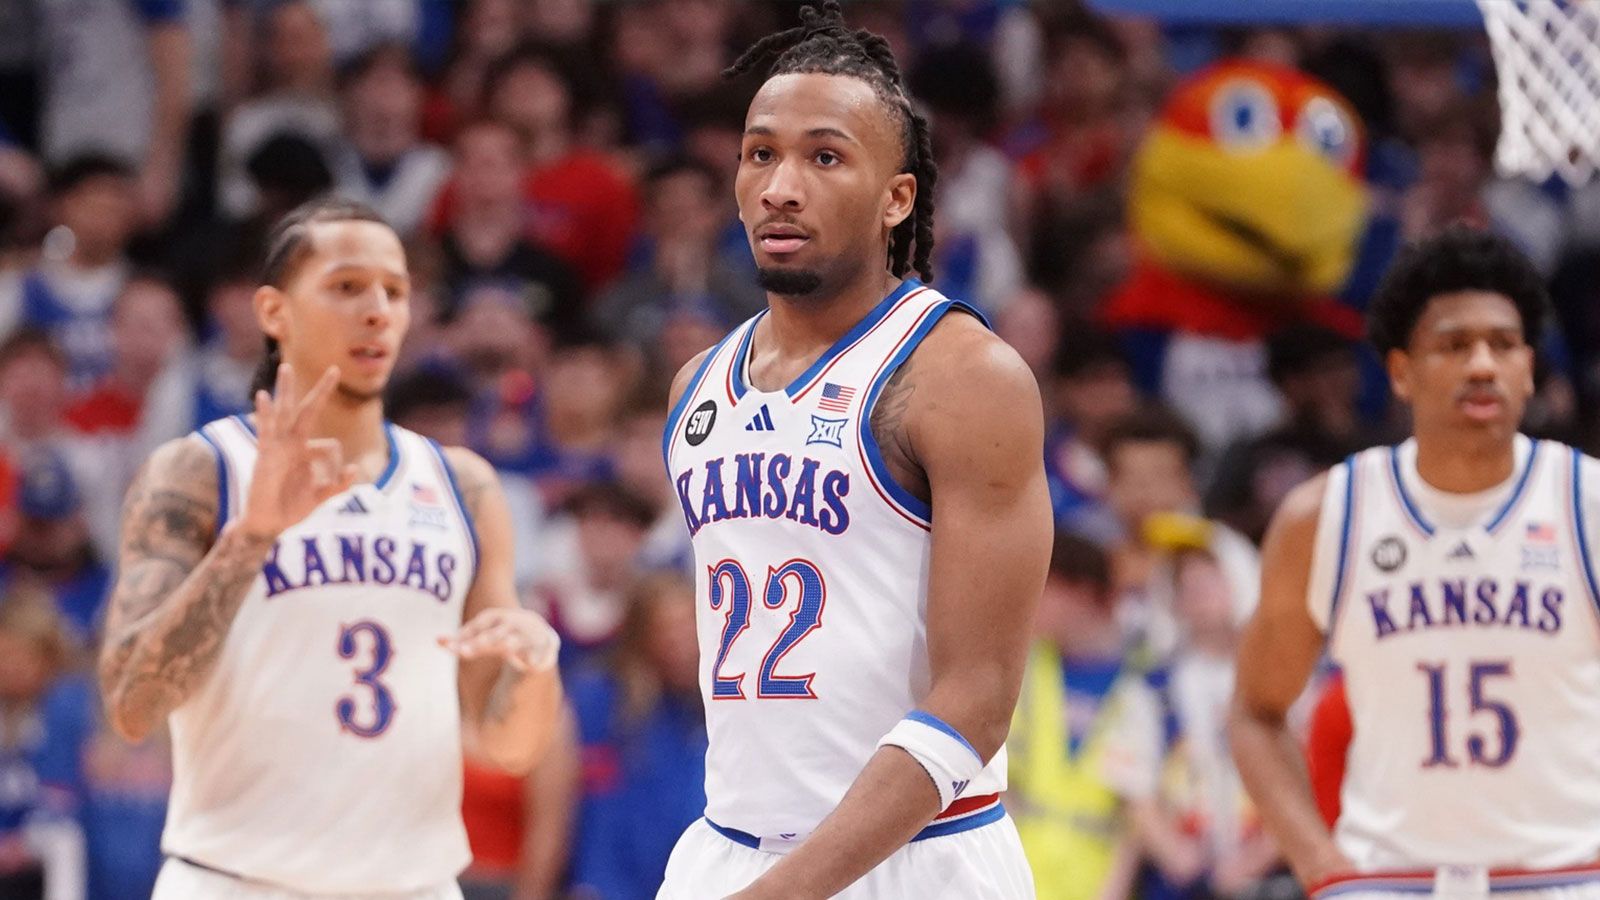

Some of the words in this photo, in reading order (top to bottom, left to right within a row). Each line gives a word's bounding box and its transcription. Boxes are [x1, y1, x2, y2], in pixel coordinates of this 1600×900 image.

[687, 408, 714, 436] SW
[677, 453, 850, 538] KANSAS
[262, 533, 456, 602] KANSAS
[1367, 577, 1564, 640] KANSAS
[707, 557, 827, 700] 22
[335, 619, 398, 739] 3
[1416, 659, 1522, 769] 15
